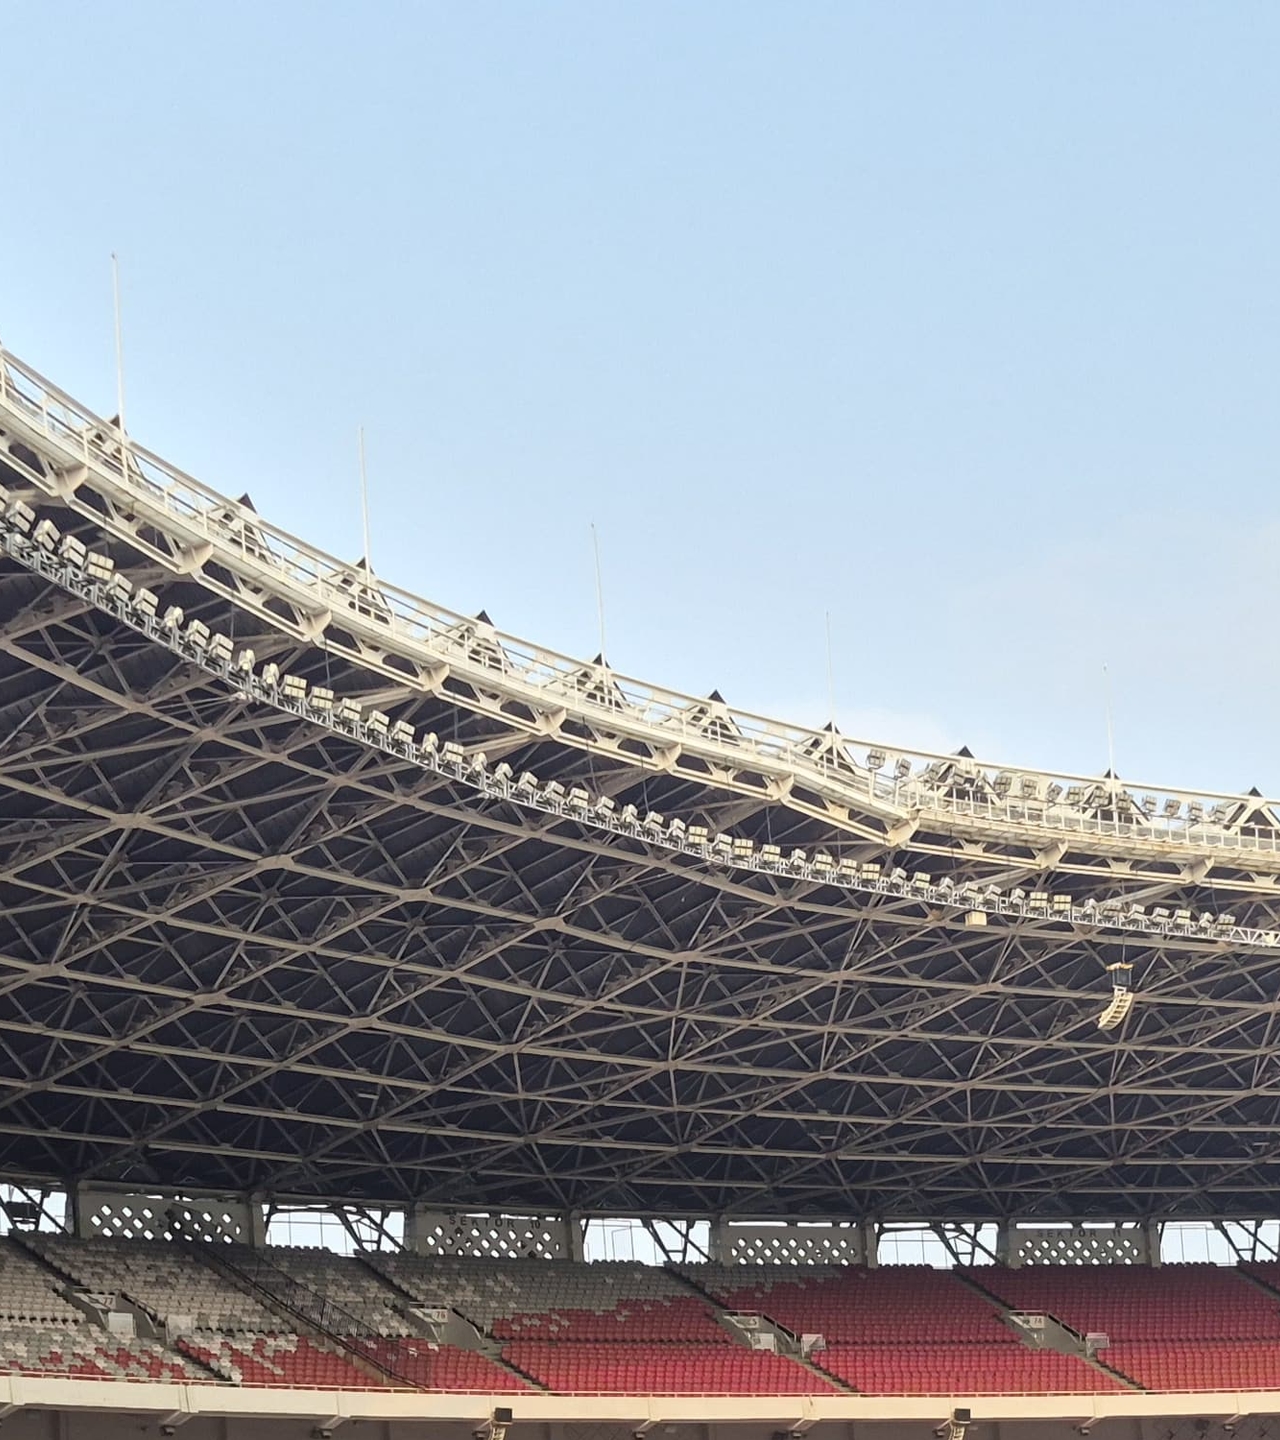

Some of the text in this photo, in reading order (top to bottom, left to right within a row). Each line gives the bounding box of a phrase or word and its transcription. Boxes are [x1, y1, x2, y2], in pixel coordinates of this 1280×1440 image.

[449, 1215, 541, 1229] SEKTOR 10
[1037, 1229, 1096, 1238] SEKTOR
